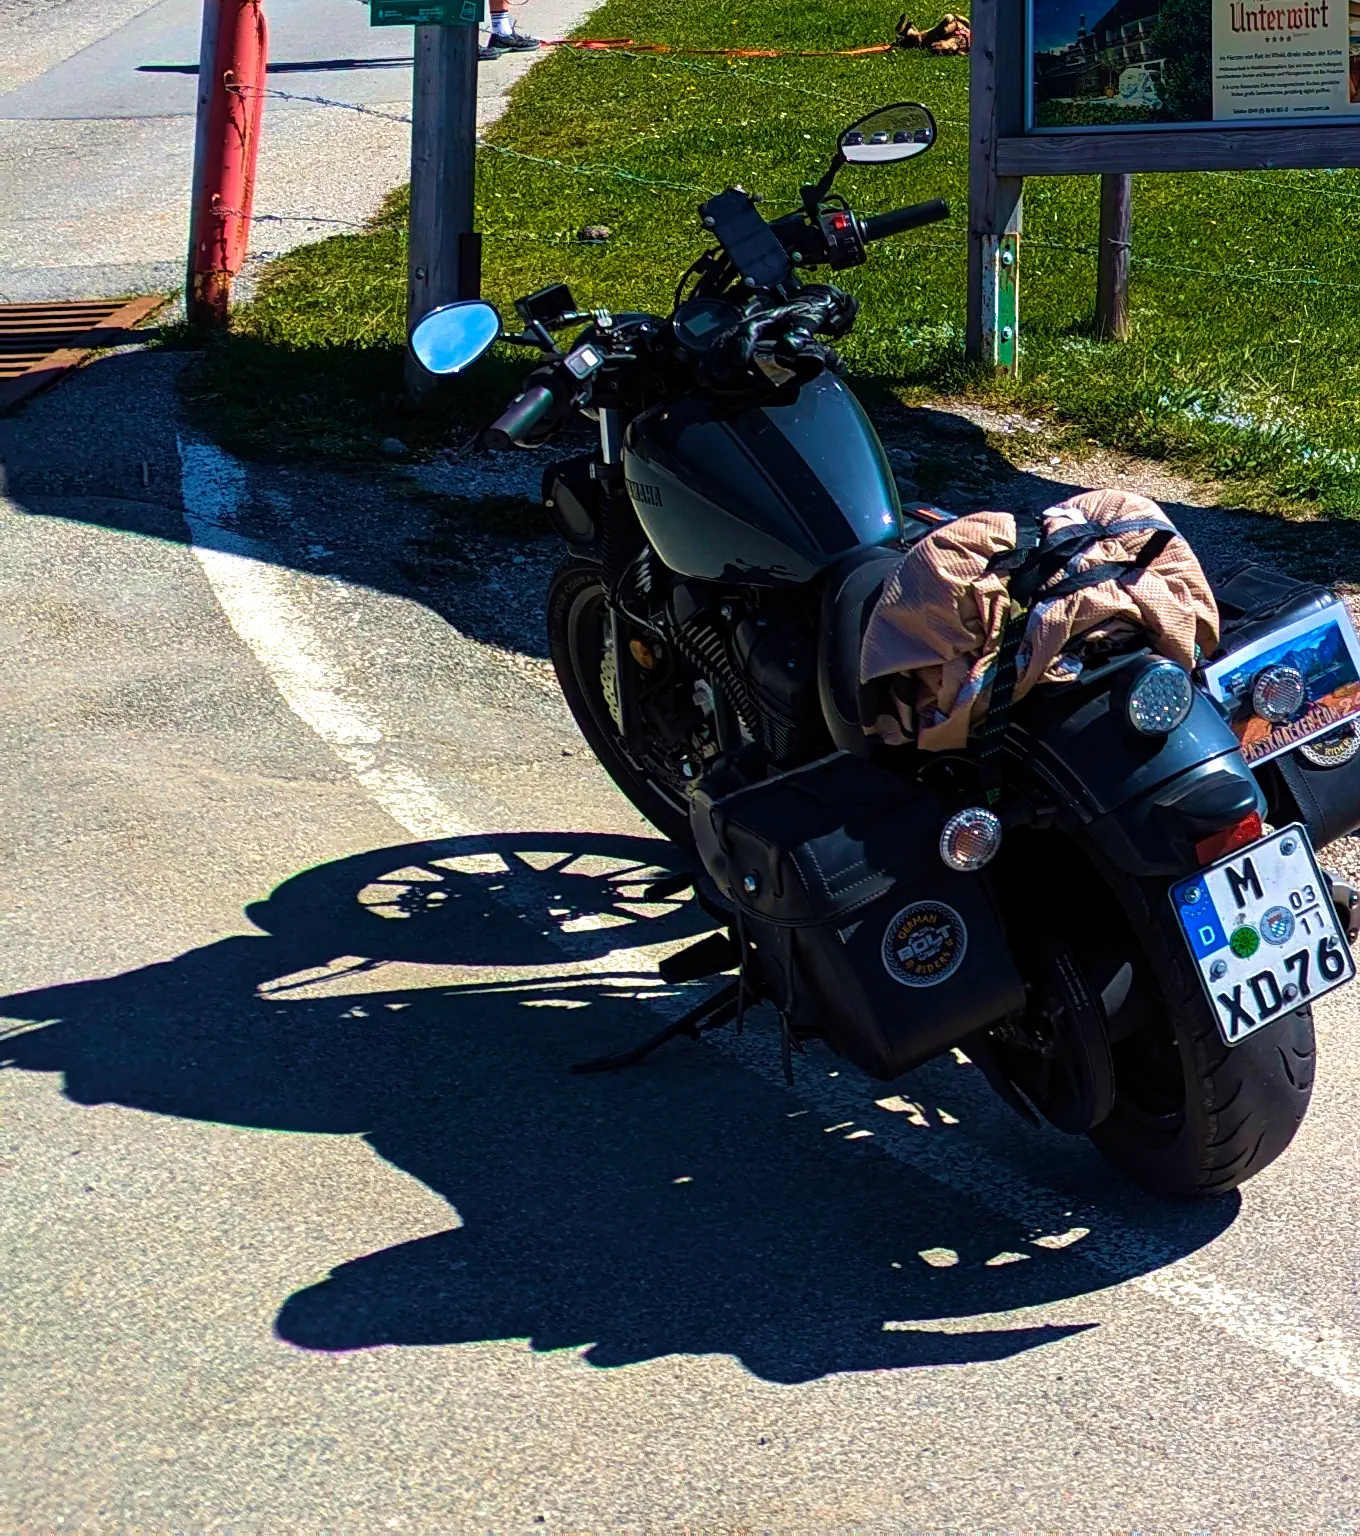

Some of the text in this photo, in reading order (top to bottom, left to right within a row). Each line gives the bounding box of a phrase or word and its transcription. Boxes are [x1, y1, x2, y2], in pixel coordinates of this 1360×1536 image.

[1224, 856, 1264, 909] M
[1289, 884, 1317, 911] 03
[1198, 925, 1216, 947] D
[1299, 911, 1325, 935] 11
[897, 924, 951, 962] BOLT
[1217, 936, 1346, 1038] XD 76
